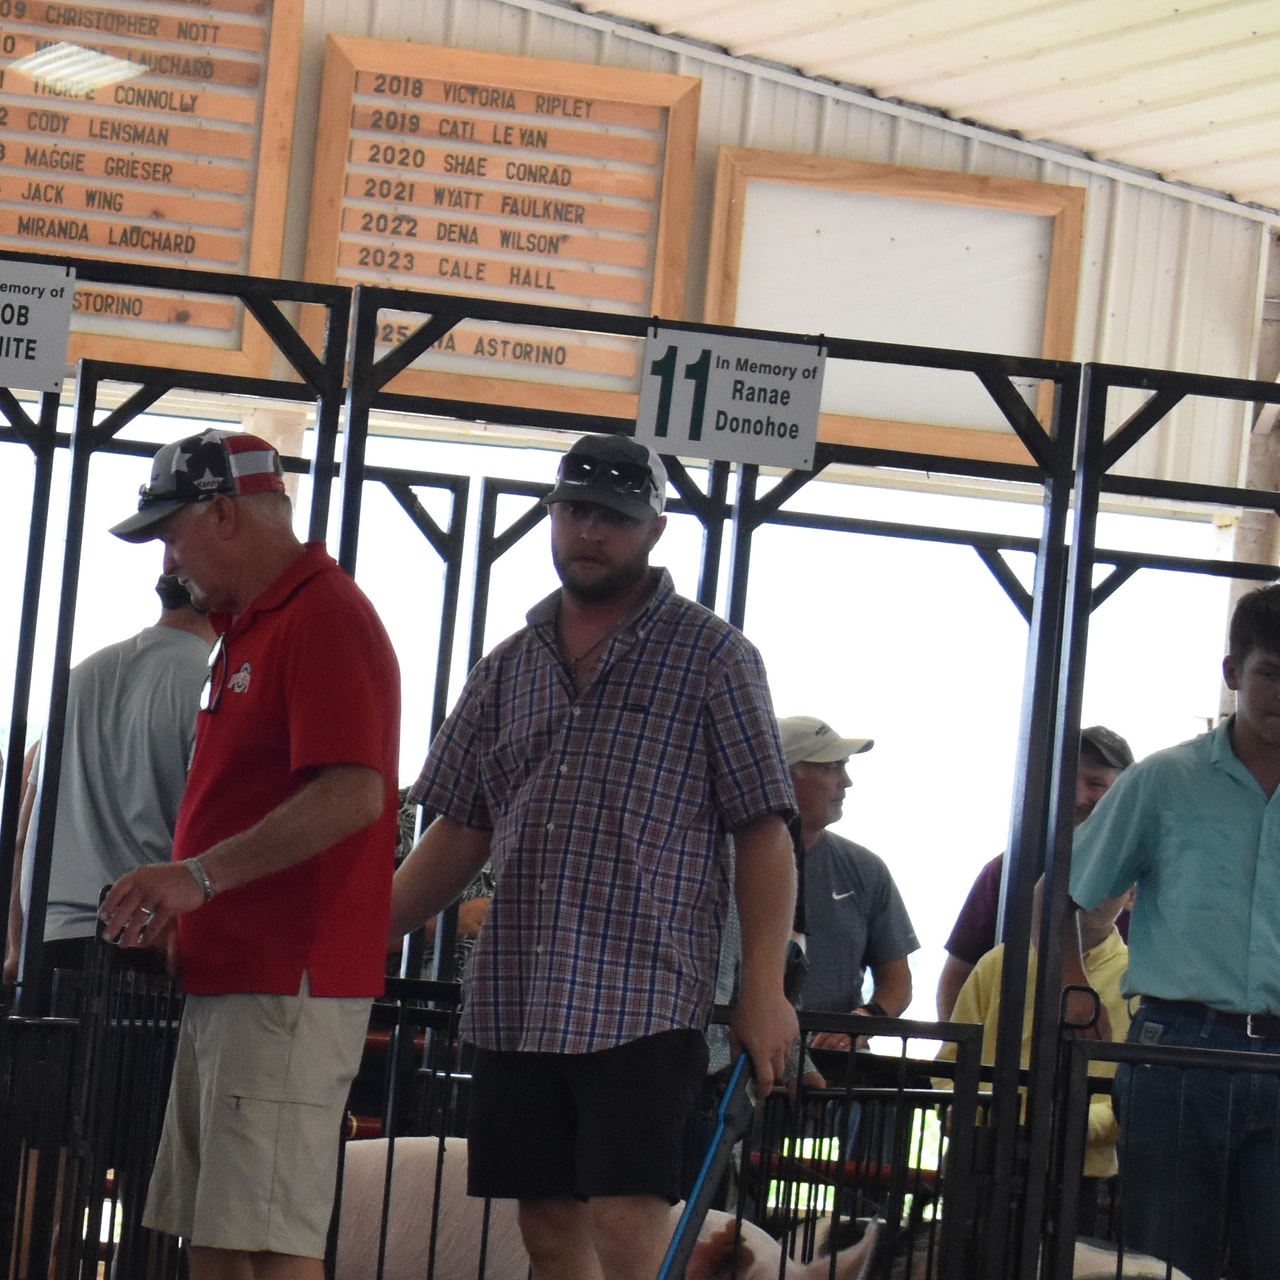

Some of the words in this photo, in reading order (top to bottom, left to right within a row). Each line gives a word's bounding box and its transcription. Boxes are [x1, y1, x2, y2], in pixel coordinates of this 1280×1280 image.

[45, 6, 159, 36] CHRISTOPHER
[177, 21, 220, 43] NOTT
[114, 85, 199, 114] CONNOLLY
[374, 75, 424, 98] 2018
[443, 83, 517, 111] VICTORIA
[535, 94, 594, 119] RIPLEY
[27, 112, 70, 134] CODY
[89, 119, 169, 147] LENSMAN
[371, 110, 420, 133] 2019
[439, 119, 475, 140] CATI
[25, 147, 86, 173] MAGGIE
[104, 157, 173, 183] GRIESER
[368, 145, 426, 169] 2020
[443, 154, 489, 178] SHAE
[506, 162, 572, 187] CONRAD
[21, 183, 65, 204] JACK
[85, 190, 124, 212] WING
[364, 179, 415, 201] 2021
[433, 187, 483, 211] WYATT
[501, 196, 586, 224] FAULKNER
[18, 216, 90, 242] MIRANDA
[109, 226, 196, 254] LAUCHARD
[360, 213, 418, 238] 2022
[436, 222, 479, 246] DENA
[500, 229, 559, 255] WILSON
[358, 248, 414, 270] 2023
[439, 259, 487, 281] CALE
[509, 267, 556, 290] HALL
[50, 285, 65, 299] of
[72, 292, 143, 317] STORINO
[376, 325, 409, 345] 25
[474, 337, 566, 365] ASTORINO
[716, 355, 730, 370] In
[735, 357, 798, 381] Memory
[802, 366, 819, 380] of
[650, 345, 712, 442] 11
[731, 379, 791, 406] Ranae
[715, 410, 799, 440] Donohoe
